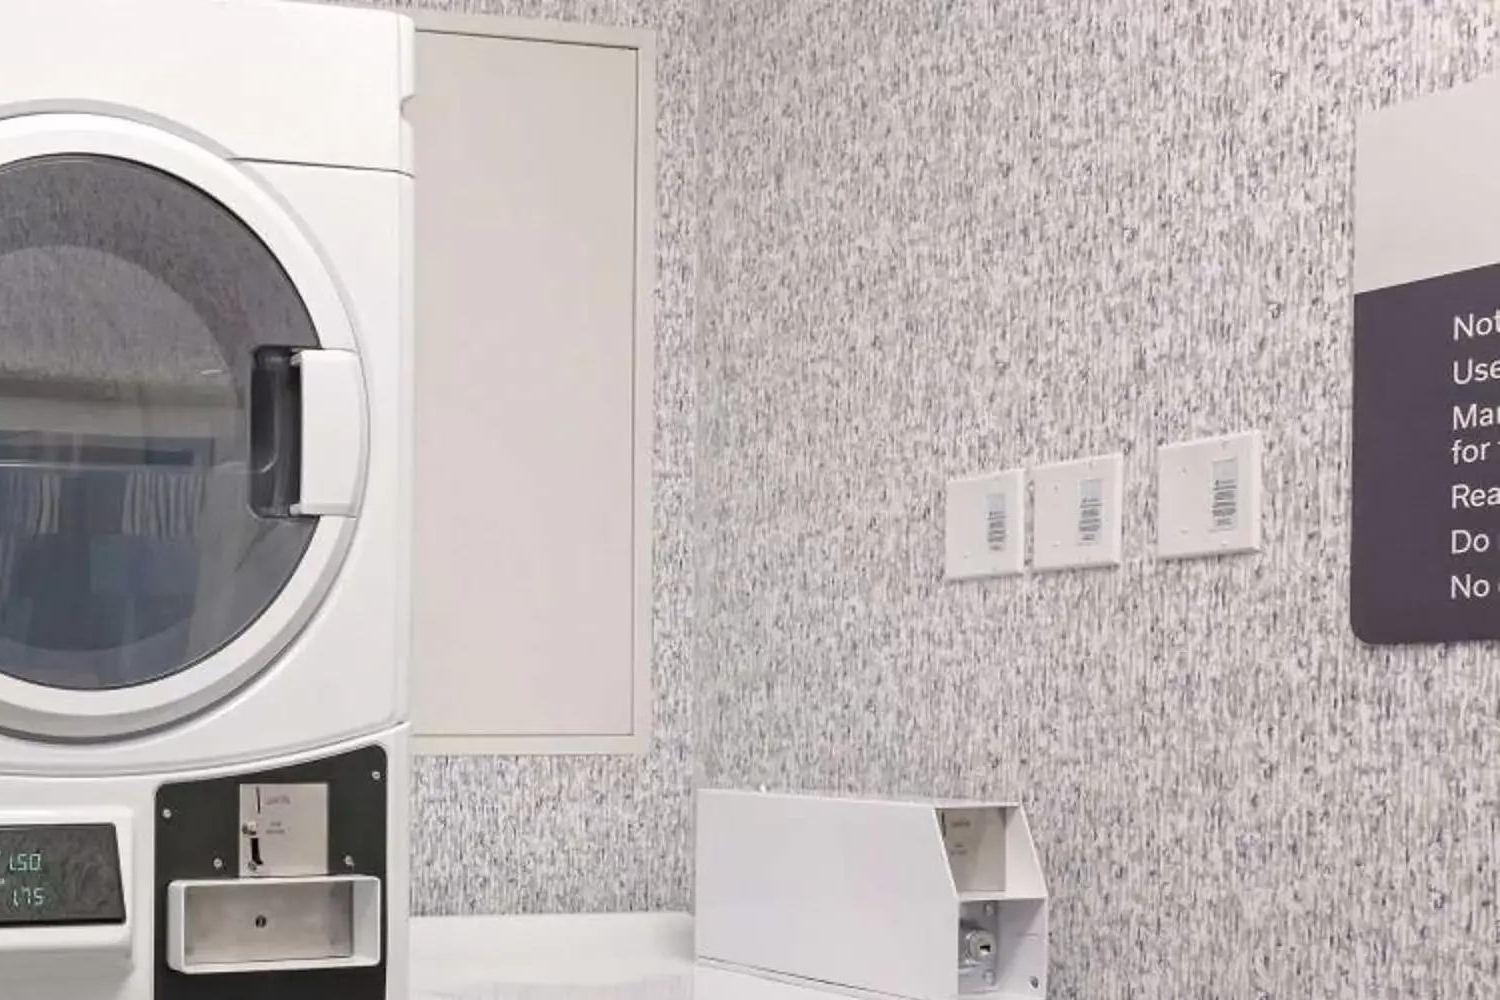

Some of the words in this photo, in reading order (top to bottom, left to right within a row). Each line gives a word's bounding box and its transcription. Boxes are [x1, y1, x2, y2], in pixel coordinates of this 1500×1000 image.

[1453, 358, 1500, 385] Use
[1451, 439, 1491, 465] for
[1452, 483, 1500, 509] Rea
[1451, 529, 1490, 555] Do
[1451, 573, 1490, 600] No
